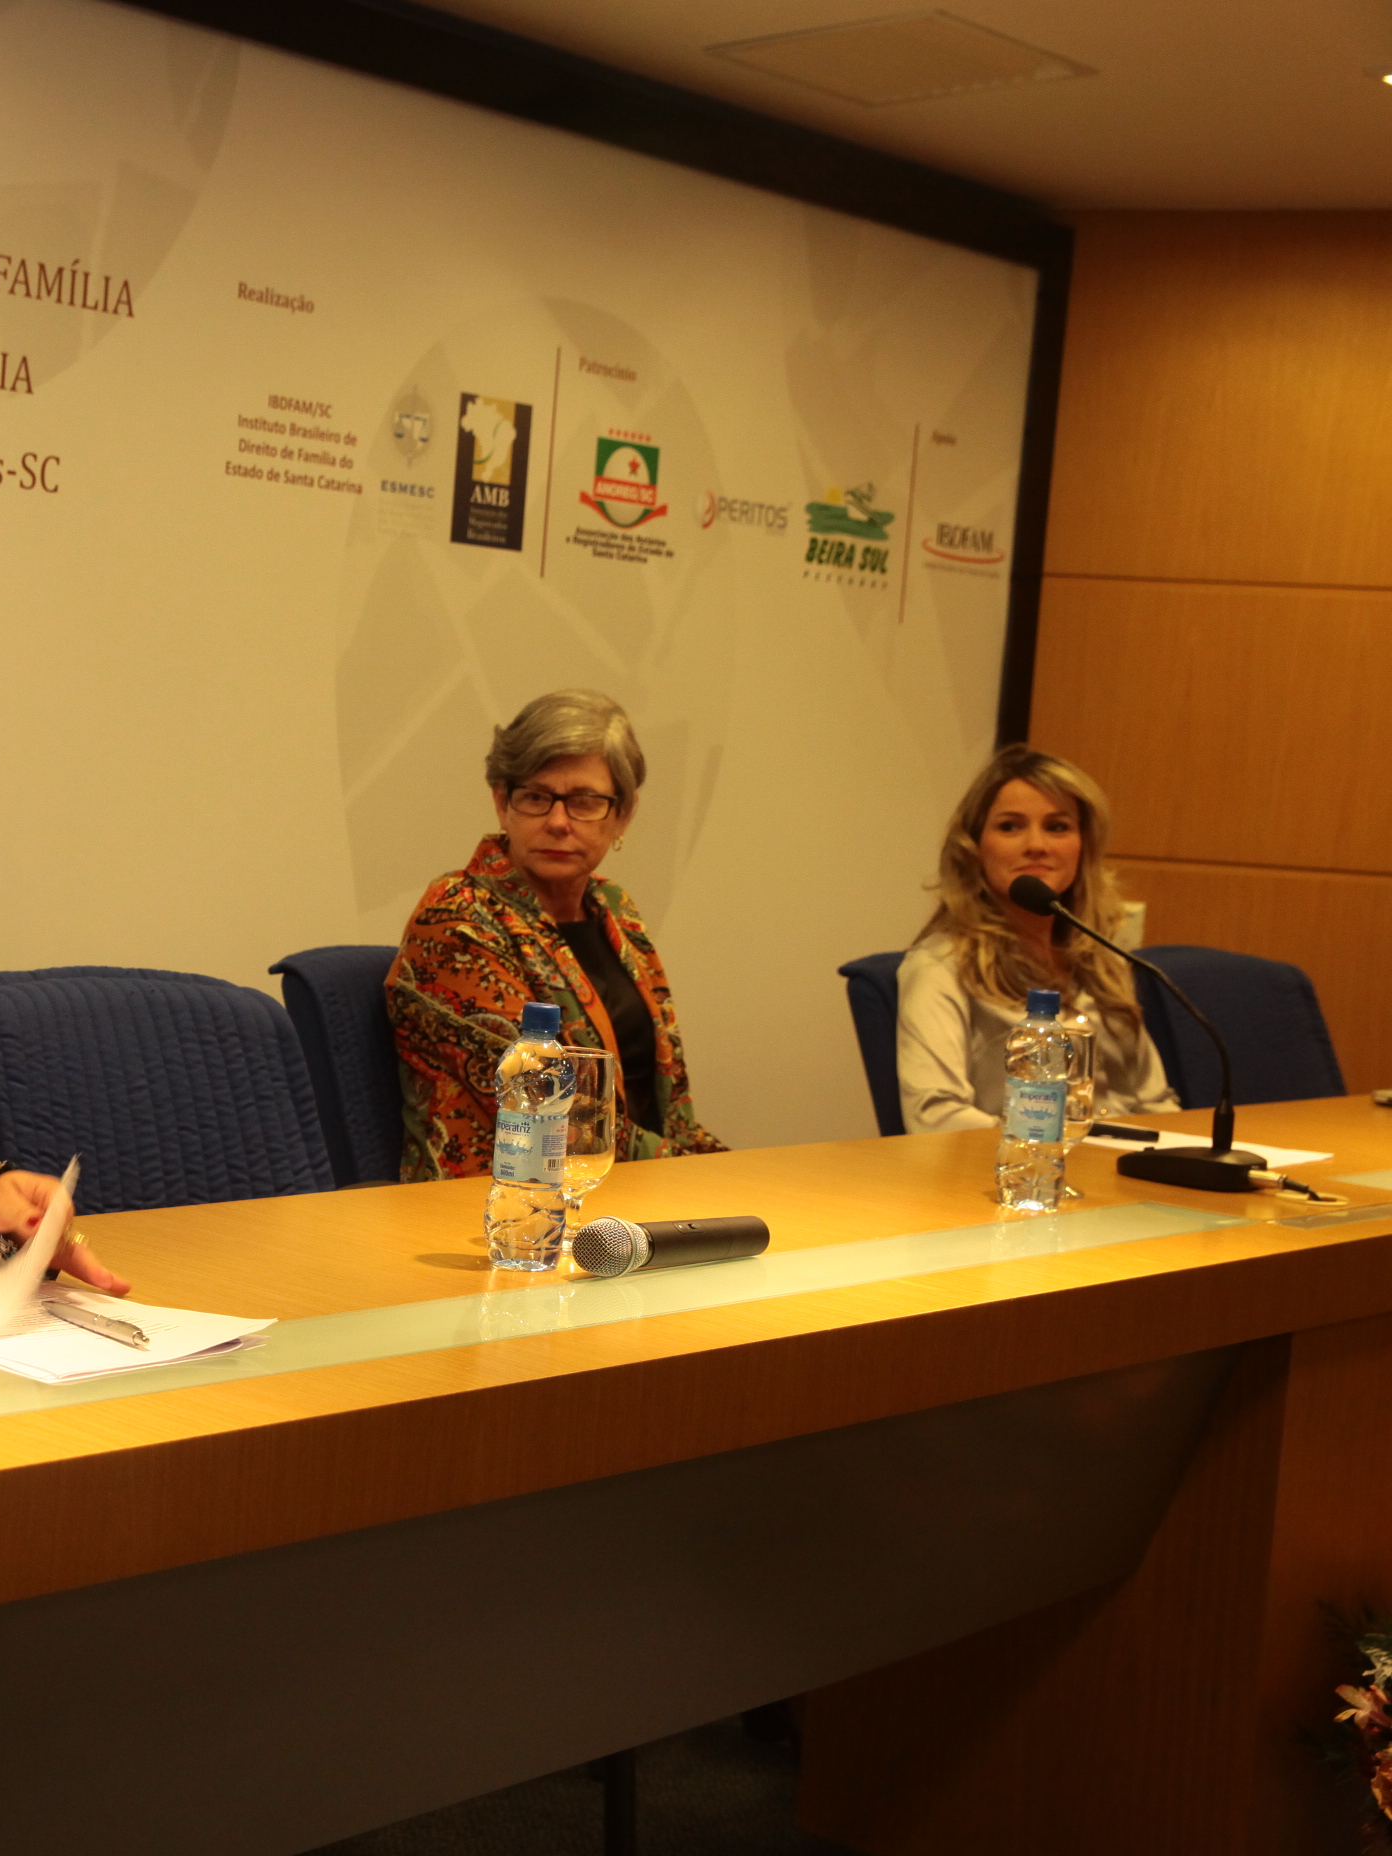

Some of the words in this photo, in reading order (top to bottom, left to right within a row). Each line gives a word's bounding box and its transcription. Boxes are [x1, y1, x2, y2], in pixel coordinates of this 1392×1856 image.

[237, 281, 315, 315] Realização
[267, 393, 333, 420] IBDFAM/SC
[237, 413, 287, 437] Instituto
[288, 421, 342, 445] Brasileiro
[343, 431, 357, 448] de
[238, 437, 278, 461] Direito
[280, 443, 295, 461] de
[296, 447, 337, 469] Família
[339, 453, 354, 470] do
[224, 460, 264, 482] Estado
[265, 465, 281, 483] de
[283, 469, 315, 488] Santa
[316, 474, 363, 496] Catarina
[380, 479, 436, 500] ESMESC
[469, 483, 511, 509] AMB
[717, 495, 789, 530] PERITOS
[804, 536, 856, 570] BEIRA
[858, 544, 890, 576] SUL
[497, 1120, 531, 1133] mperatriz
